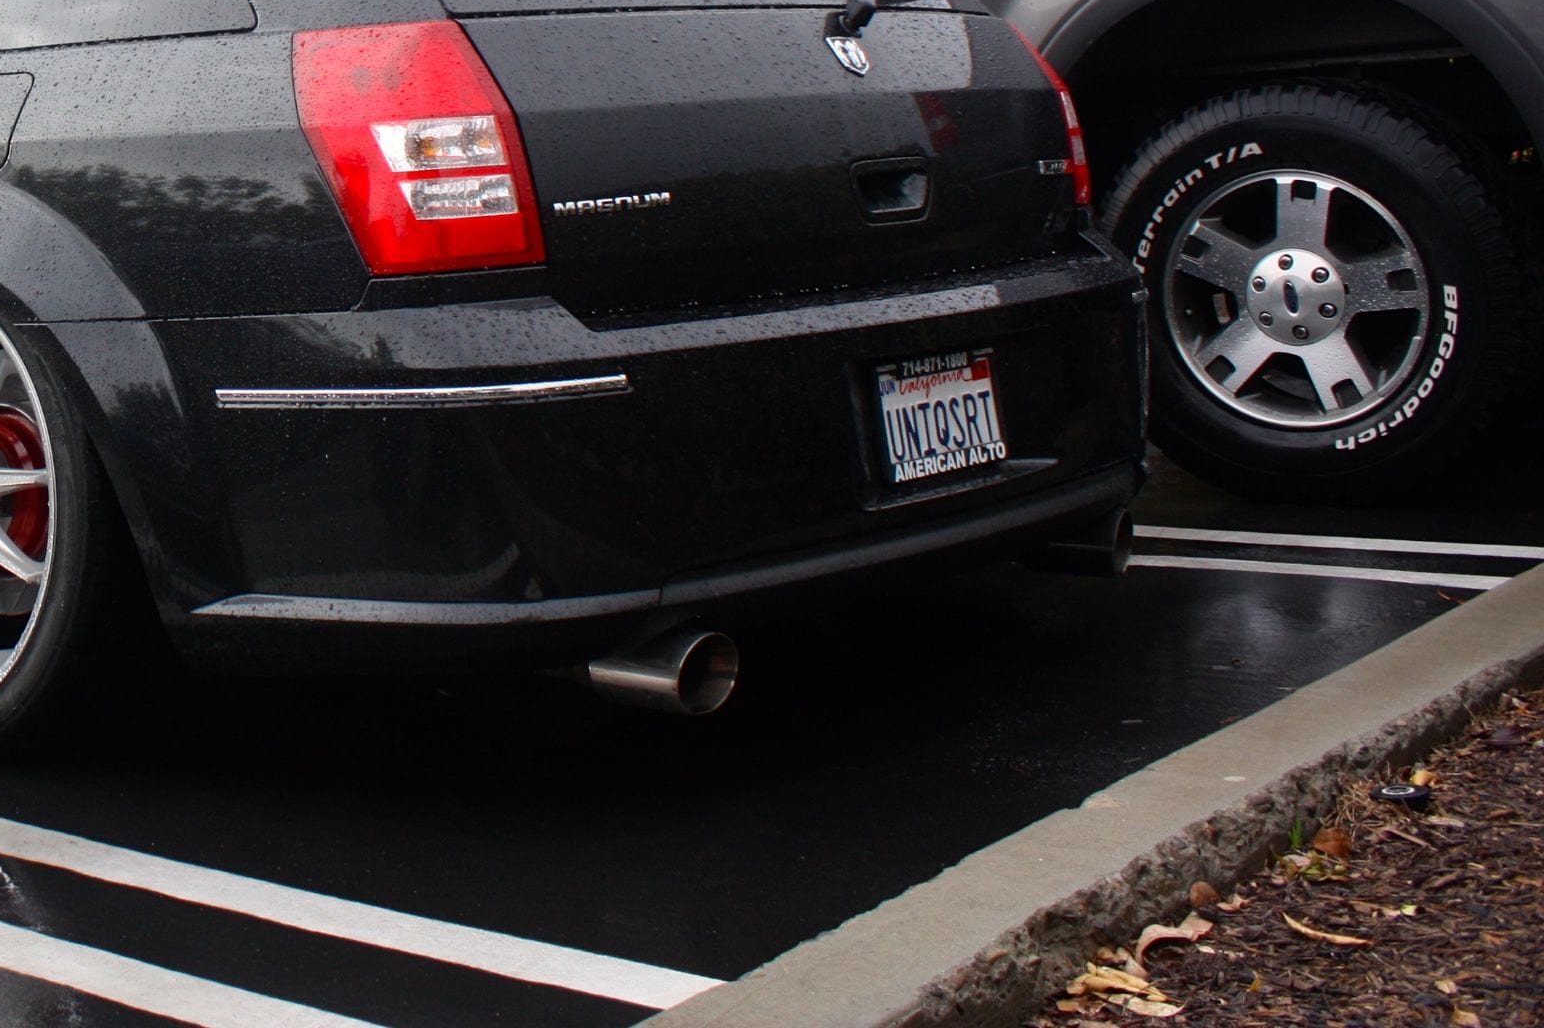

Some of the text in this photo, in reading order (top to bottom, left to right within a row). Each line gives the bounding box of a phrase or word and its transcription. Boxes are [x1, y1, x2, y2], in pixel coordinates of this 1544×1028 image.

[1204, 141, 1264, 171] T/A
[553, 191, 671, 217] MAGNUM
[1334, 284, 1459, 452] BFGoodrich
[886, 389, 995, 463] UNIQSRT
[894, 440, 1007, 483] AMERICAN AUTO
